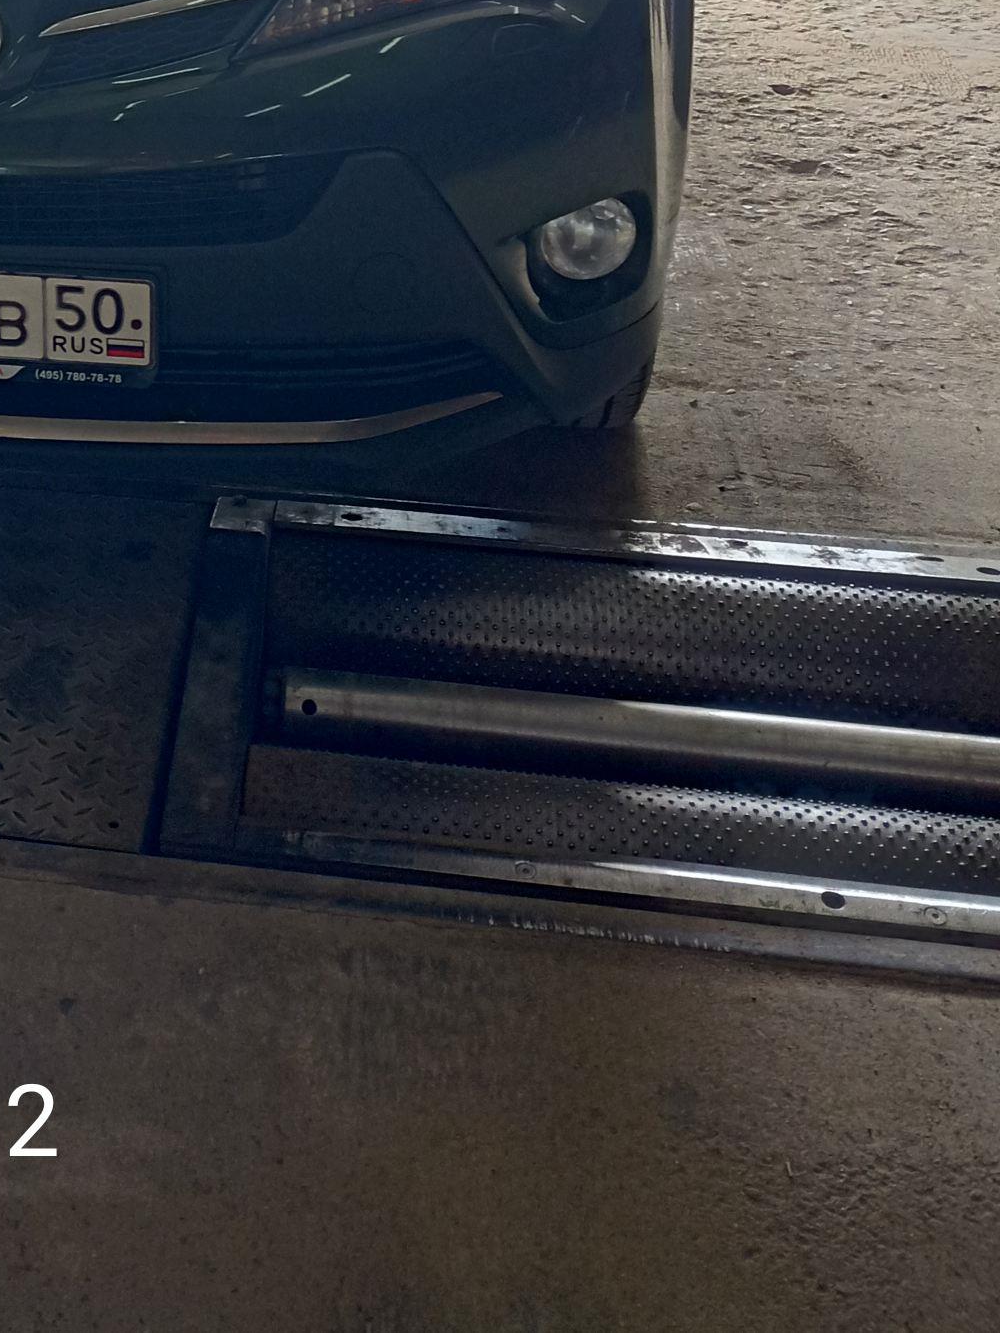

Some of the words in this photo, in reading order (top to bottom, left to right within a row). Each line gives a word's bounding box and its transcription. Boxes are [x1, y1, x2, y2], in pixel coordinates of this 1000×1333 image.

[54, 284, 124, 335] 50
[52, 335, 104, 355] RUS
[35, 369, 64, 381] (495)
[66, 371, 122, 384] 780-78-78
